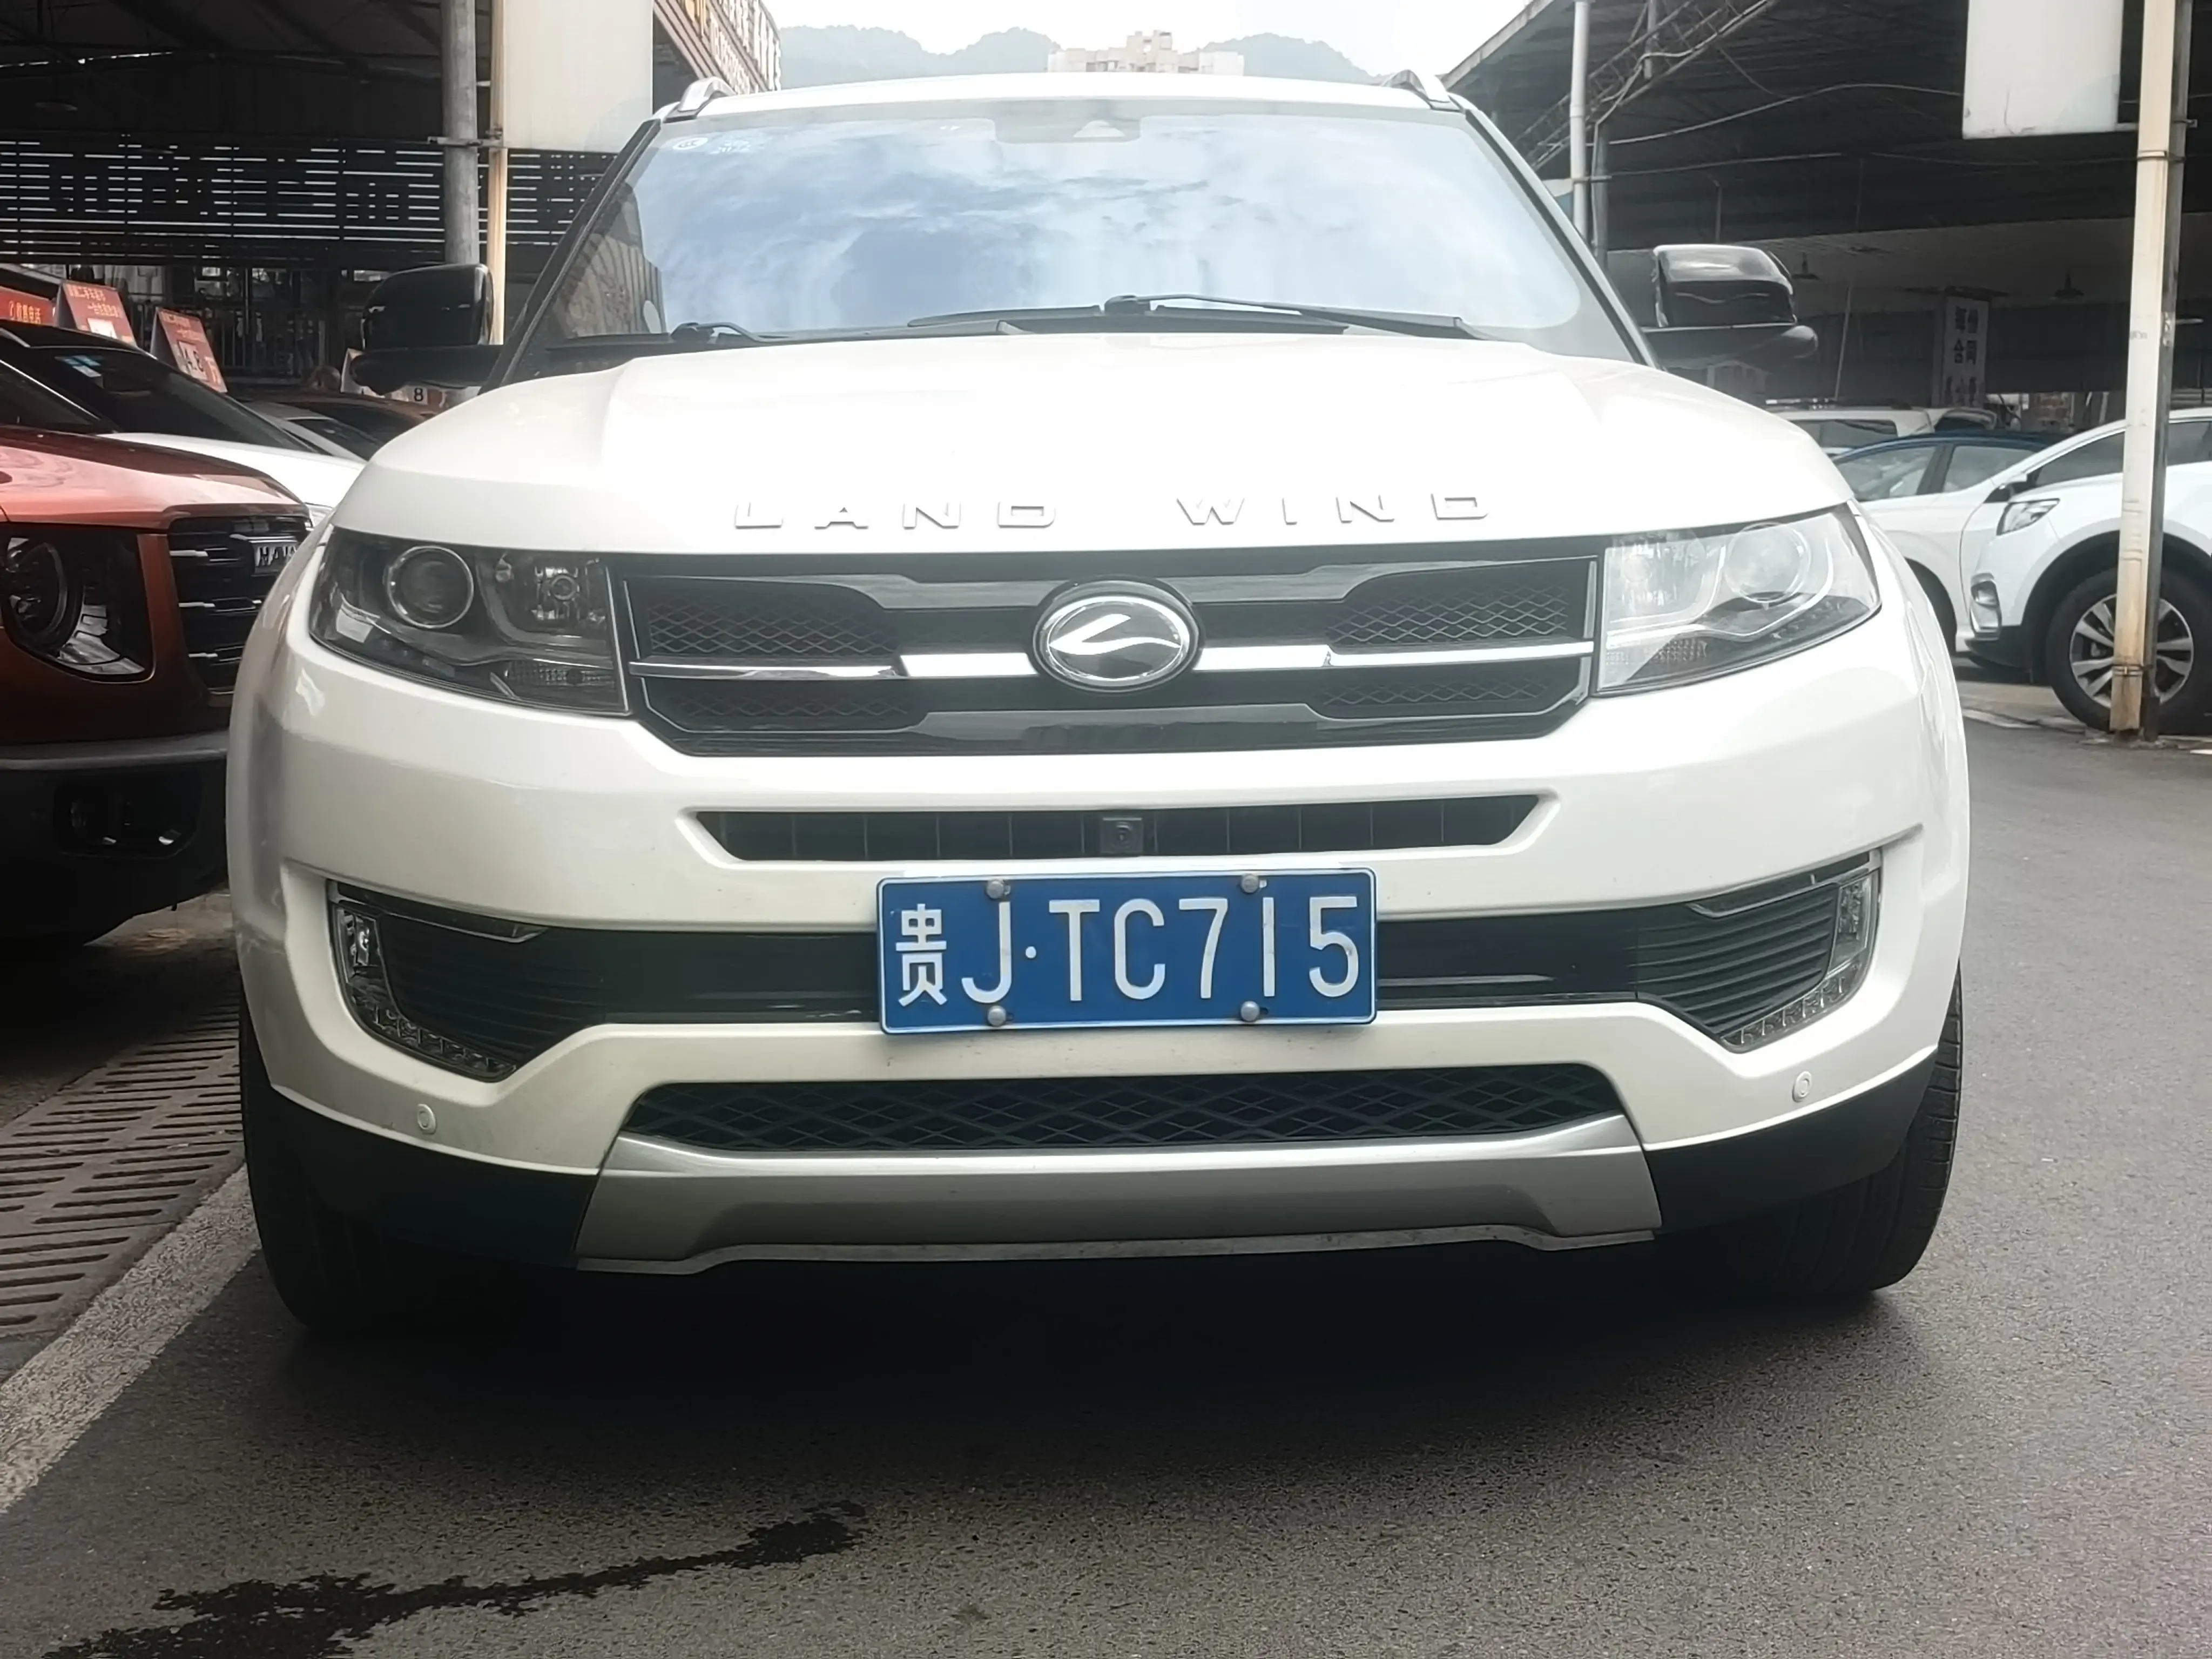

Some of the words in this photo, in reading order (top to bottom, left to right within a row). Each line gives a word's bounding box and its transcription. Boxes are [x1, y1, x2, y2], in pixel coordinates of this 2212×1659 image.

[734, 498, 1056, 530] LAND
[1176, 493, 1489, 525] WIND
[895, 896, 1359, 1006] 贵J·TC715
